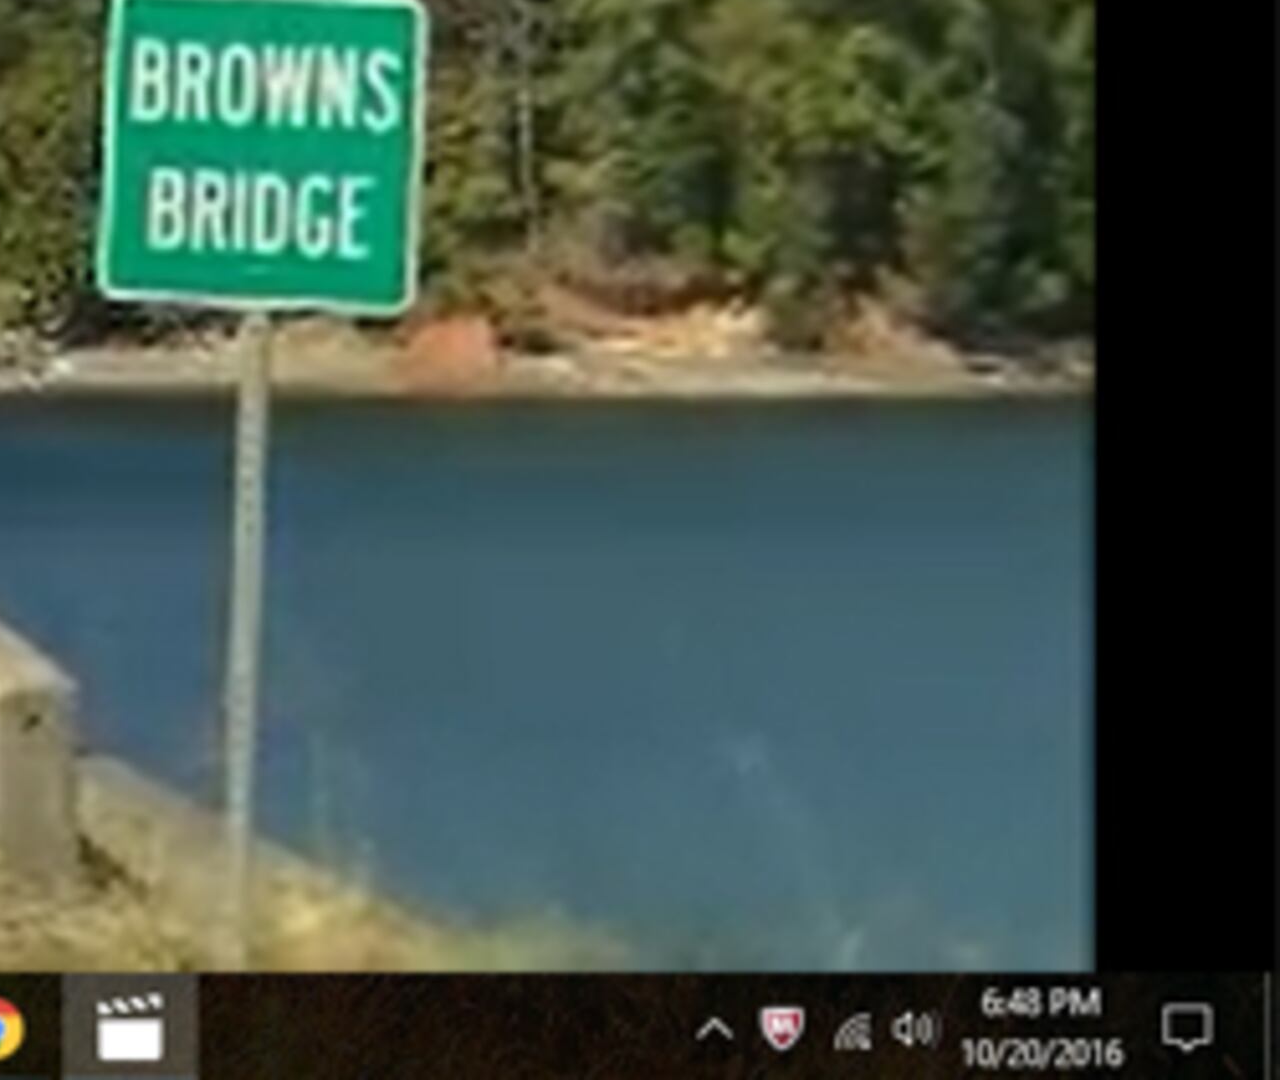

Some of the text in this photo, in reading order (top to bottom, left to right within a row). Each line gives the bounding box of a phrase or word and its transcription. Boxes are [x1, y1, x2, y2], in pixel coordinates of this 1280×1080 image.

[128, 36, 404, 134] BROWNS
[146, 166, 378, 261] BRIDGE
[981, 985, 1103, 1018] 6:48 PM
[960, 1036, 1127, 1069] 10/20/2016
